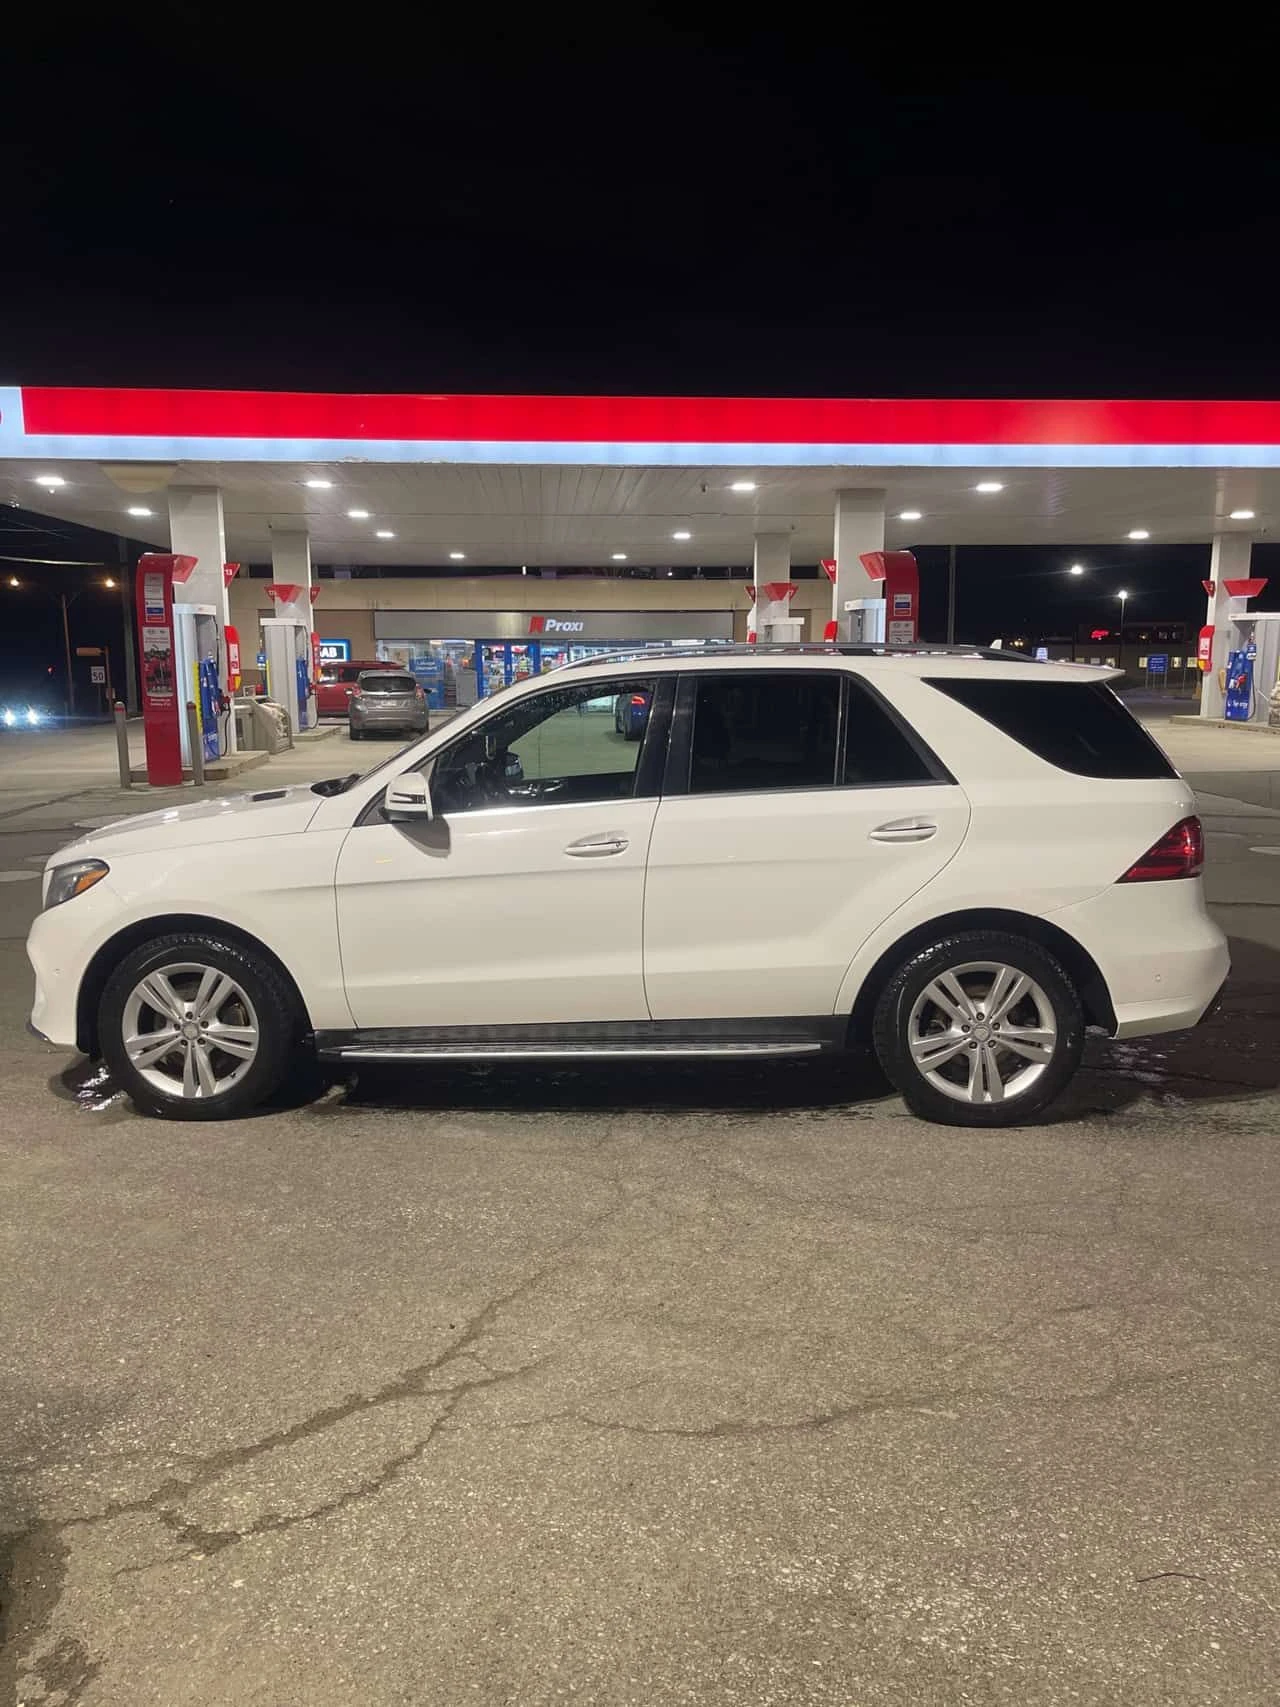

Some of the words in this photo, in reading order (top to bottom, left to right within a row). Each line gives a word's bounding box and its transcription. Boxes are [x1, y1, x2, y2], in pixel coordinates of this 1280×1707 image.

[545, 619, 584, 632] Proxi
[320, 646, 338, 658] AB
[93, 671, 104, 681] 50
